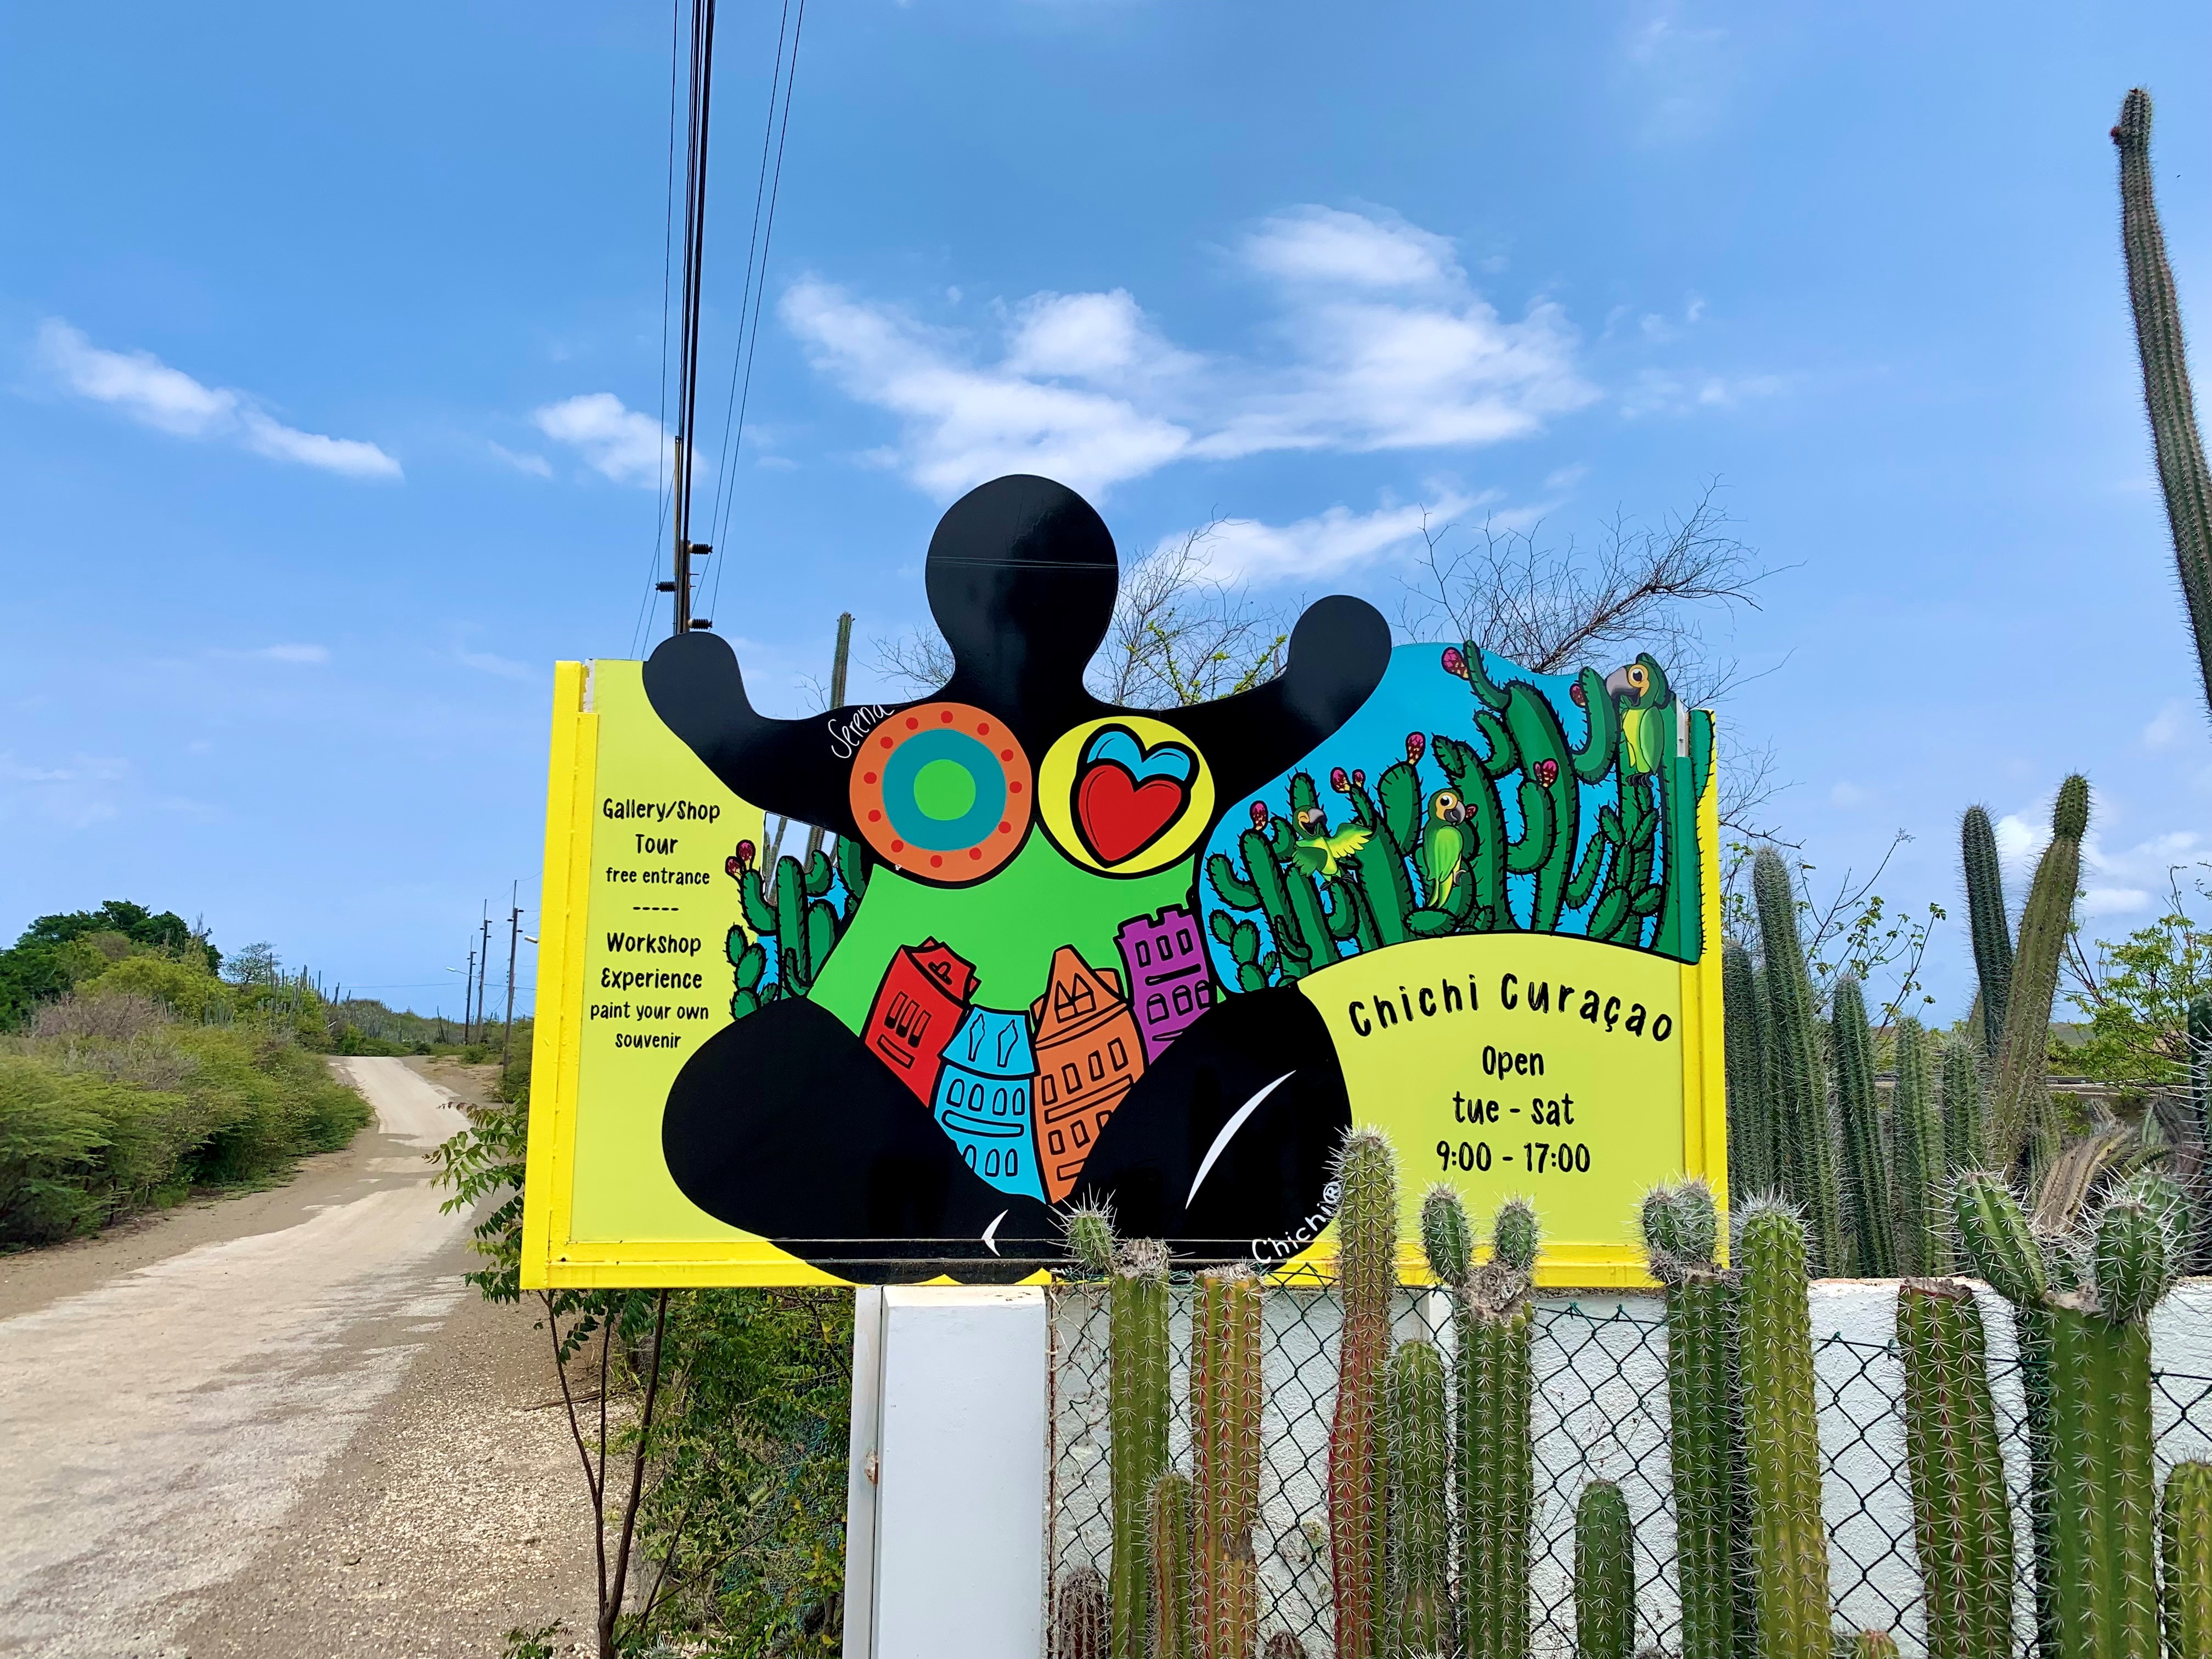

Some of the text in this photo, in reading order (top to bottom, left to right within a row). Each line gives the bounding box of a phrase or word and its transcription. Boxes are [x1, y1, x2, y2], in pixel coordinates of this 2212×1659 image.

[828, 704, 895, 758] Serena
[603, 798, 720, 823] Gallery/Shop
[636, 834, 678, 855] Tour
[606, 867, 709, 885] free entrance
[607, 932, 701, 957] Workshop
[601, 967, 702, 991] Experience
[591, 1002, 709, 1021] paint your own
[1349, 973, 1672, 1041] Chichi Curaçao
[616, 1032, 681, 1048] souvenir
[1483, 1046, 1544, 1080] Open
[1453, 1091, 1499, 1125] tue
[1531, 1093, 1575, 1126] sat
[1437, 1141, 1491, 1171] 9:00
[1523, 1142, 1590, 1173] 17:00
